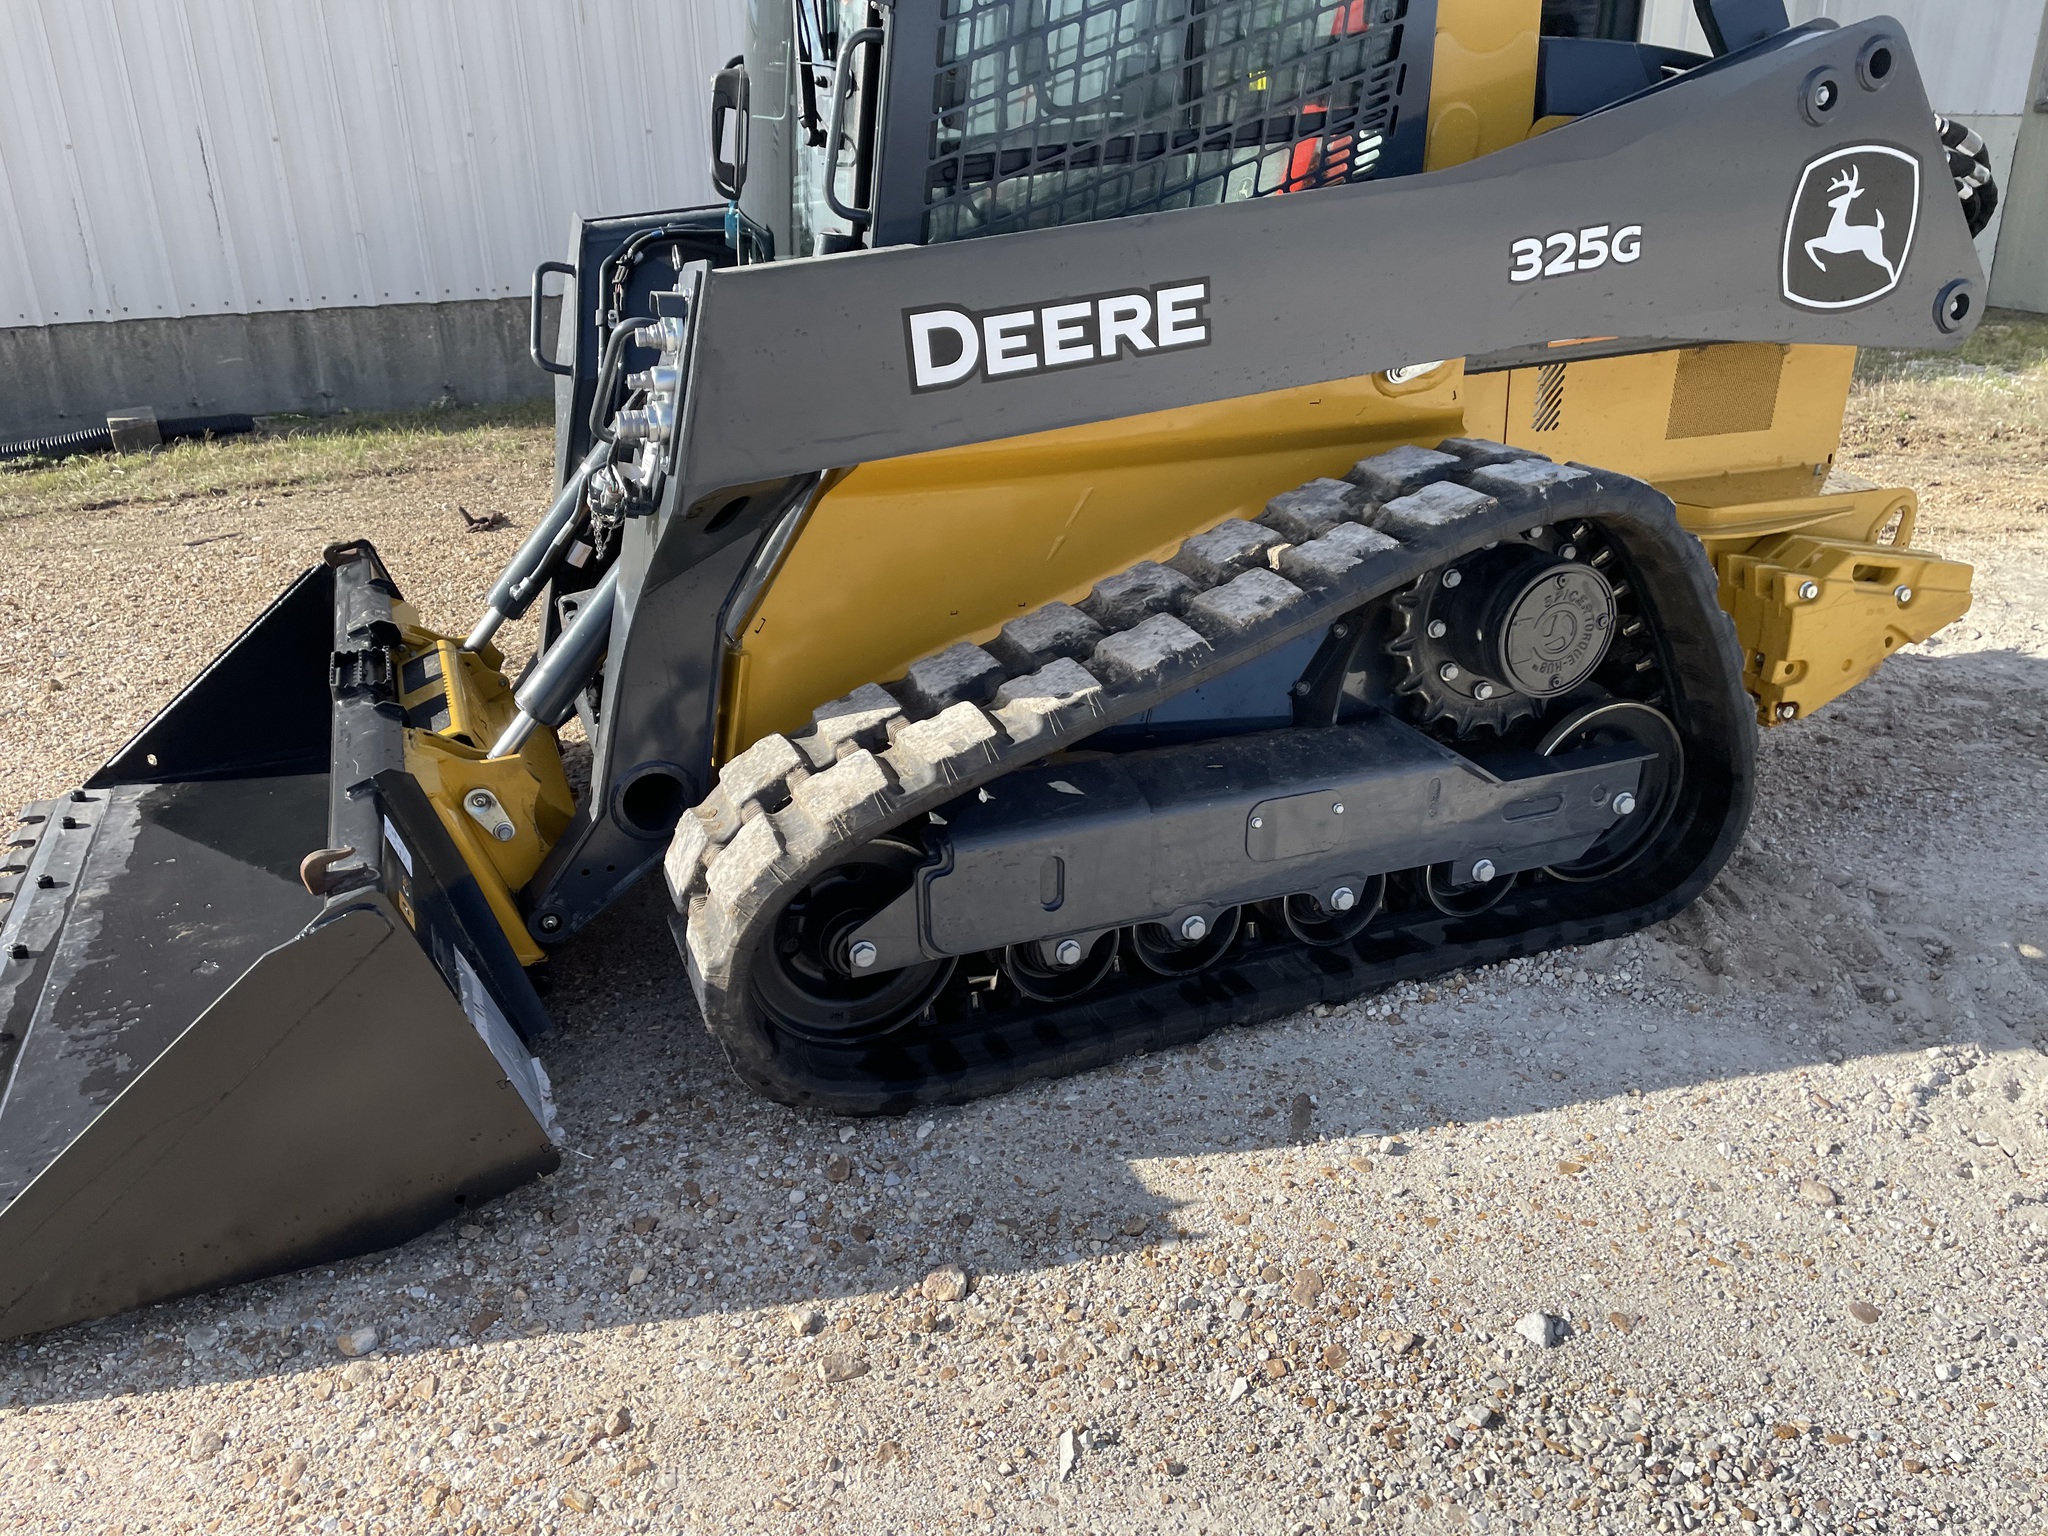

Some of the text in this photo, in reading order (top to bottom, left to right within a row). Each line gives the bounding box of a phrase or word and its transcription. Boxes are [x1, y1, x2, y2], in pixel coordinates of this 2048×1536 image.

[1510, 225, 1642, 282] 325G
[909, 283, 1206, 387] DEERE
[1543, 588, 1593, 615] SPICER
